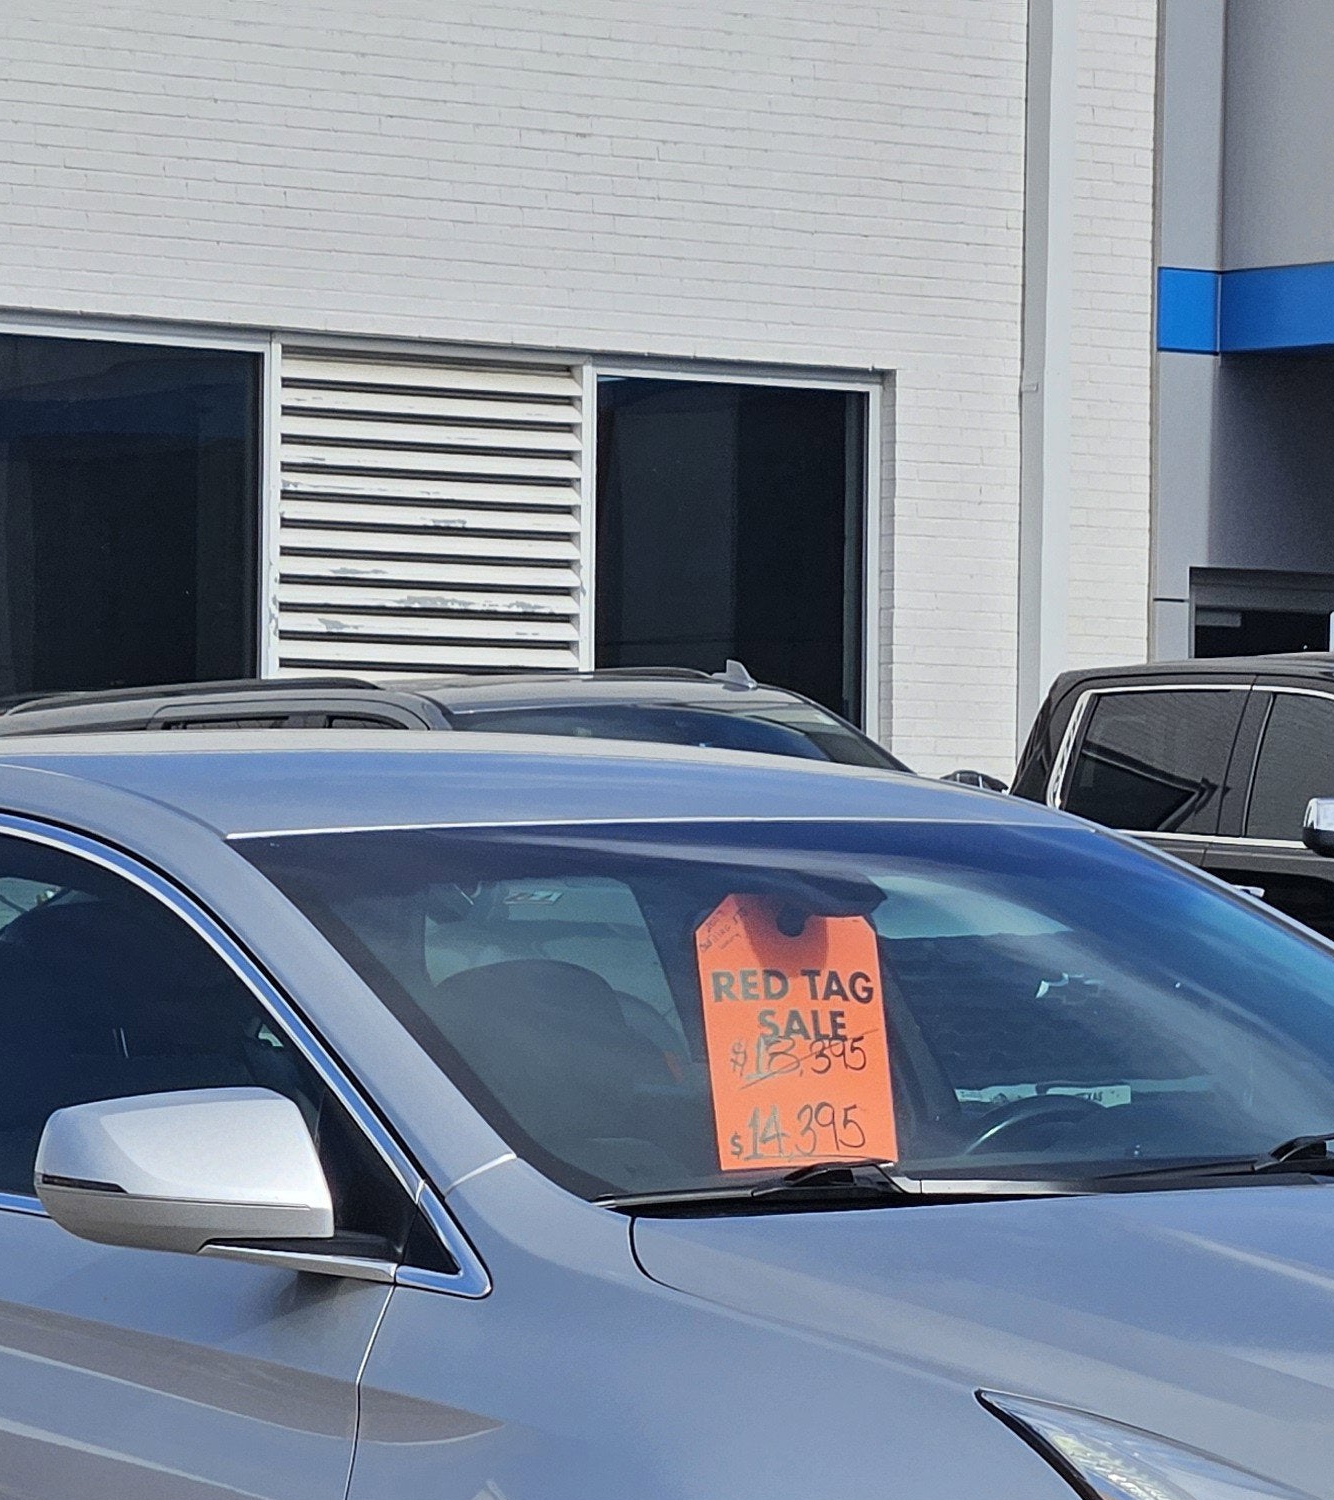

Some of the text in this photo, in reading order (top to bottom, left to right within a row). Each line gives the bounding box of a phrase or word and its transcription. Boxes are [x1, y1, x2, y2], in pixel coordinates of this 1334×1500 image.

[712, 969, 874, 1004] RED TAG
[758, 1009, 848, 1042] SALE
